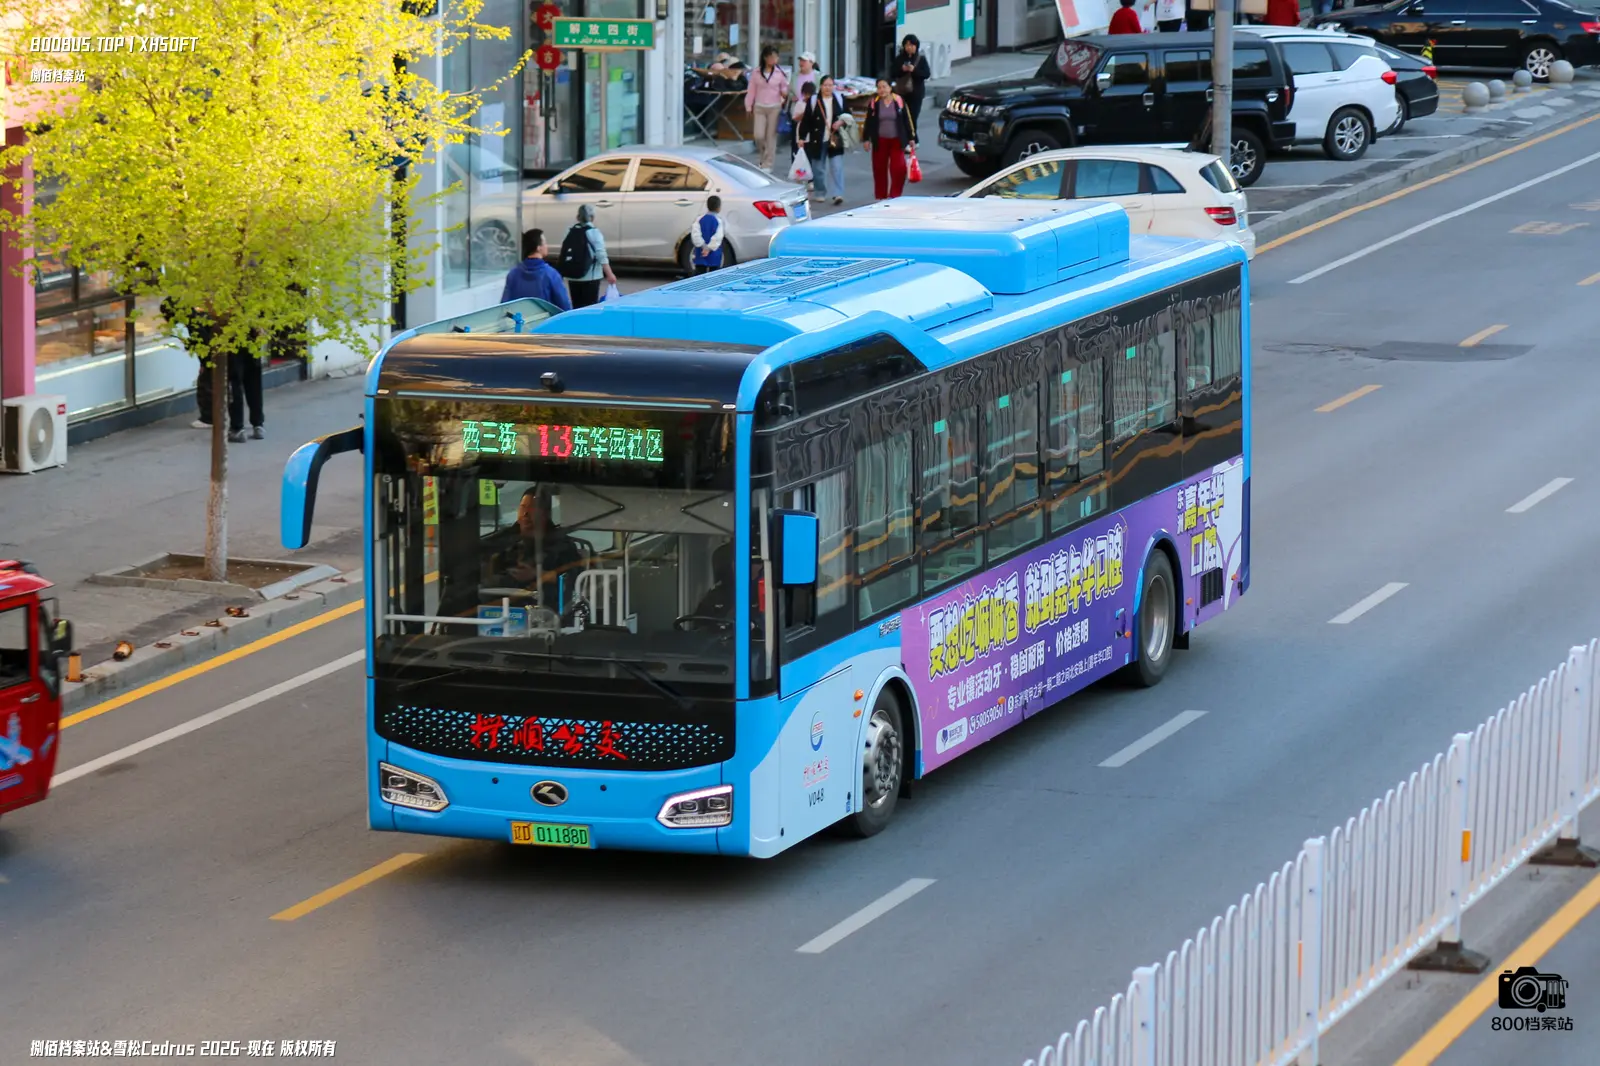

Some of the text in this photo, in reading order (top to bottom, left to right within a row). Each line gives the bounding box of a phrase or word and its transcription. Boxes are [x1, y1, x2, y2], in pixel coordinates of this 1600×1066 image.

[569, 23, 639, 36] 解放四街
[538, 424, 573, 457] 13
[572, 426, 664, 462] 东华园社区
[929, 525, 1123, 682] 要想吃嘛嘛香 就到嘉年华口腔
[809, 788, 825, 807] V048
[537, 826, 588, 845] 01188D
